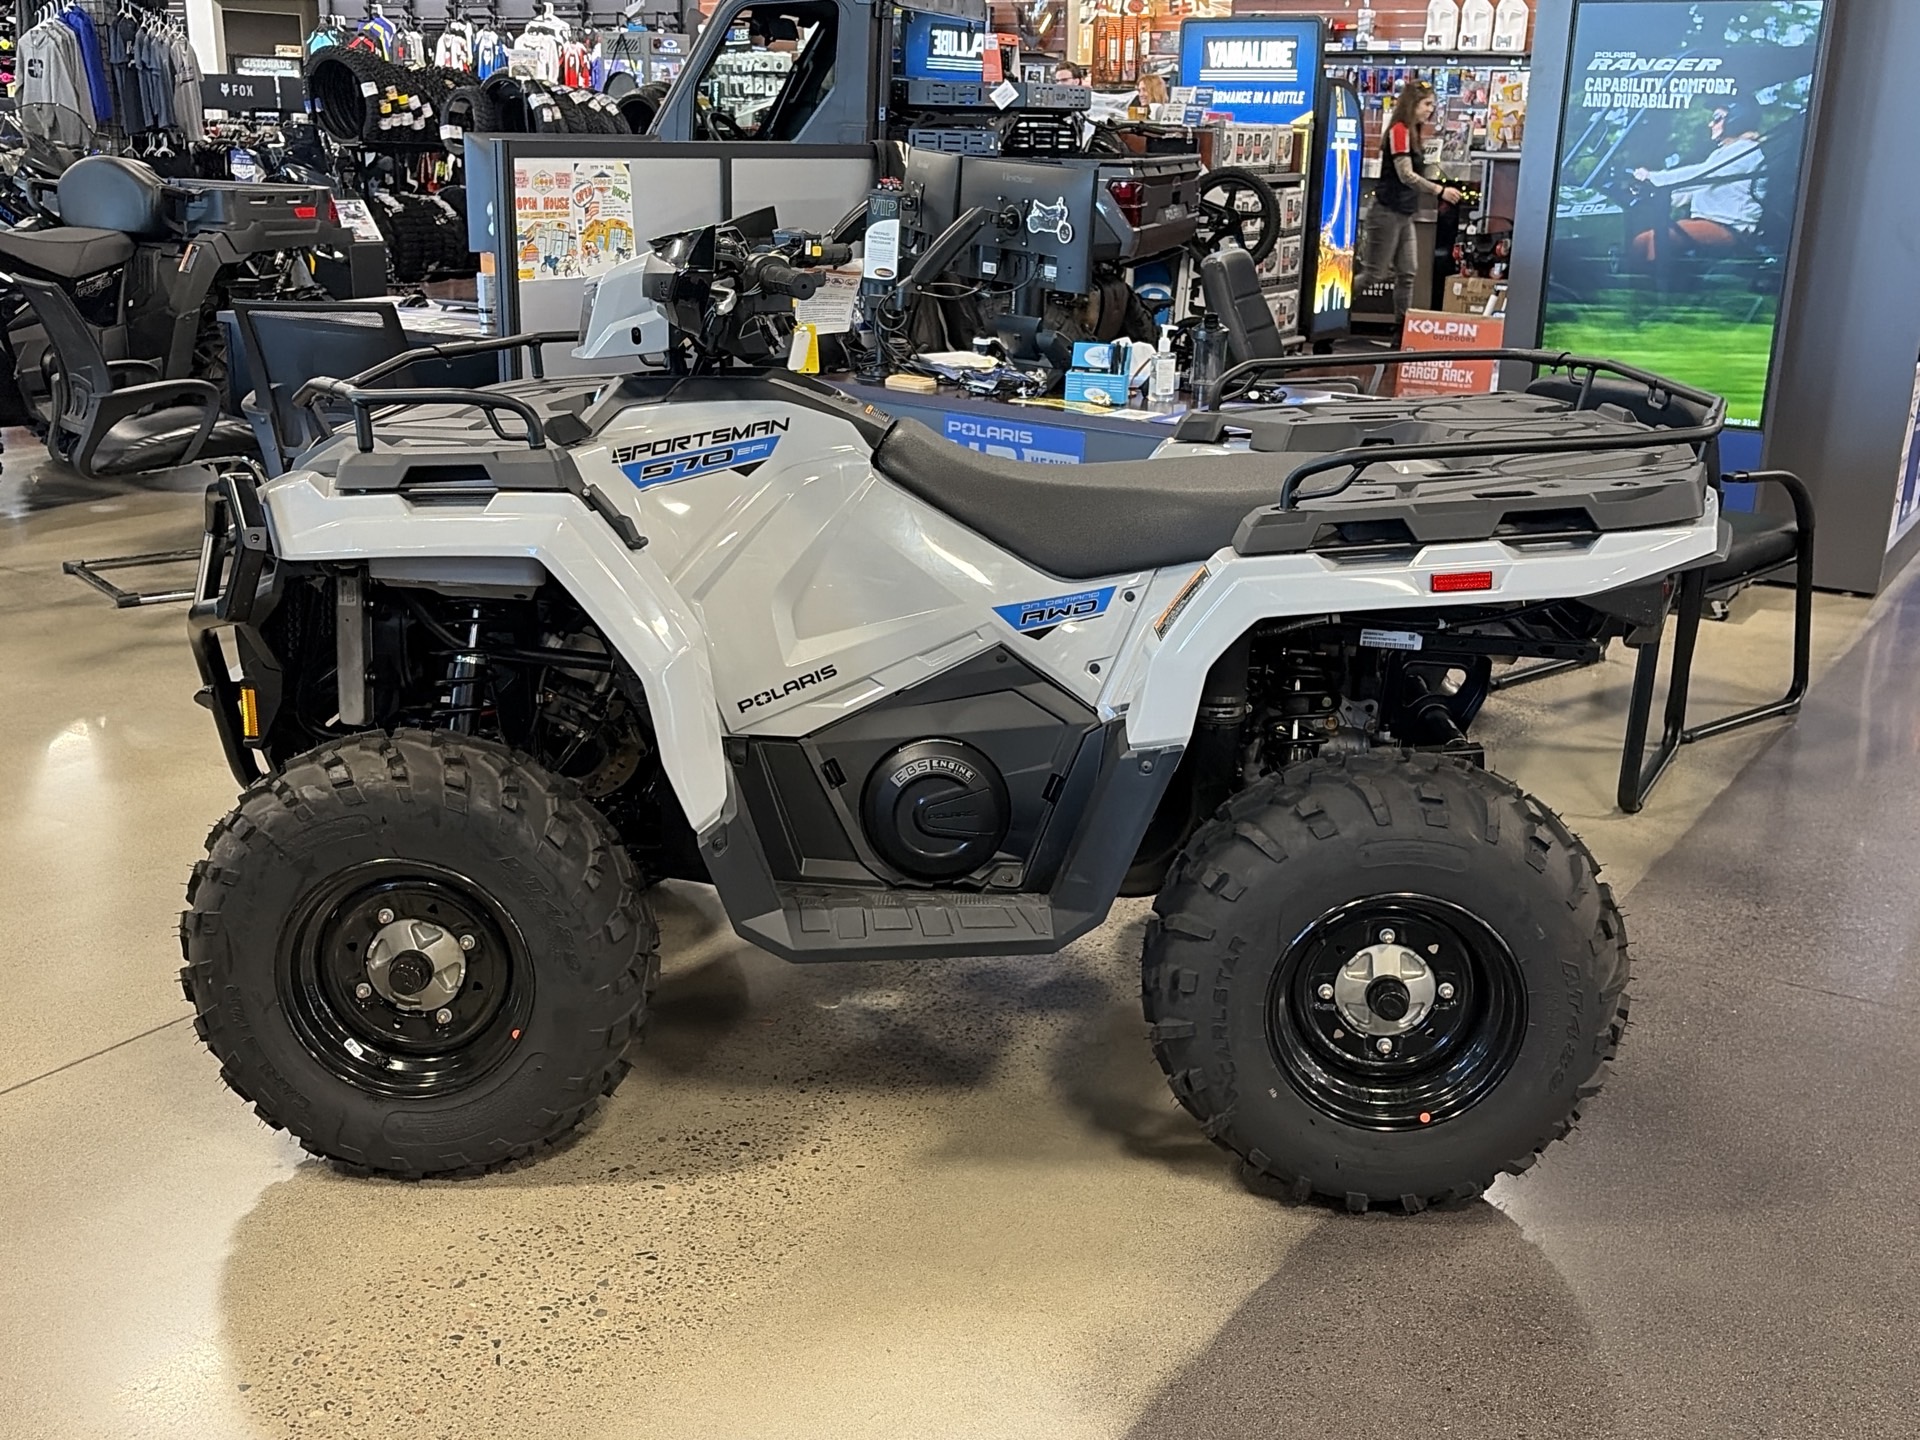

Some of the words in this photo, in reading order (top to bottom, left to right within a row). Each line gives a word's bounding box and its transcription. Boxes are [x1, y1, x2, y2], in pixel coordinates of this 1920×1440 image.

[242, 58, 292, 69] GATORADE
[1207, 41, 1293, 68] YAMALUBE
[1587, 58, 1722, 71] RANGER
[232, 84, 254, 97] FOX
[1585, 77, 1666, 94] CAPABILITY,
[1669, 78, 1738, 96] COMFORT,
[1253, 91, 1263, 104] IN
[1264, 91, 1271, 104] A
[1272, 91, 1305, 105] BOTTLE
[1583, 93, 1611, 108] AND
[1613, 94, 1694, 109] DURABILITY
[516, 197, 537, 210] OPEN
[543, 197, 570, 210] HOUSE
[869, 198, 898, 217] VIP
[1408, 320, 1477, 336] KOLPIN
[1433, 335, 1476, 343] OUTDOORS
[1401, 365, 1438, 380] CARGO
[1442, 369, 1475, 384] RACK
[612, 417, 790, 464] SPORTSMAN
[948, 421, 1033, 444] POLARIS
[641, 449, 734, 480] 570
[737, 443, 768, 456] EFI
[1021, 602, 1040, 610] ON
[1045, 591, 1100, 607] DEMAND
[1020, 600, 1099, 626] AWD
[737, 664, 838, 713] POLARIS
[895, 761, 928, 784] EBS
[932, 760, 973, 778] ENGINE
